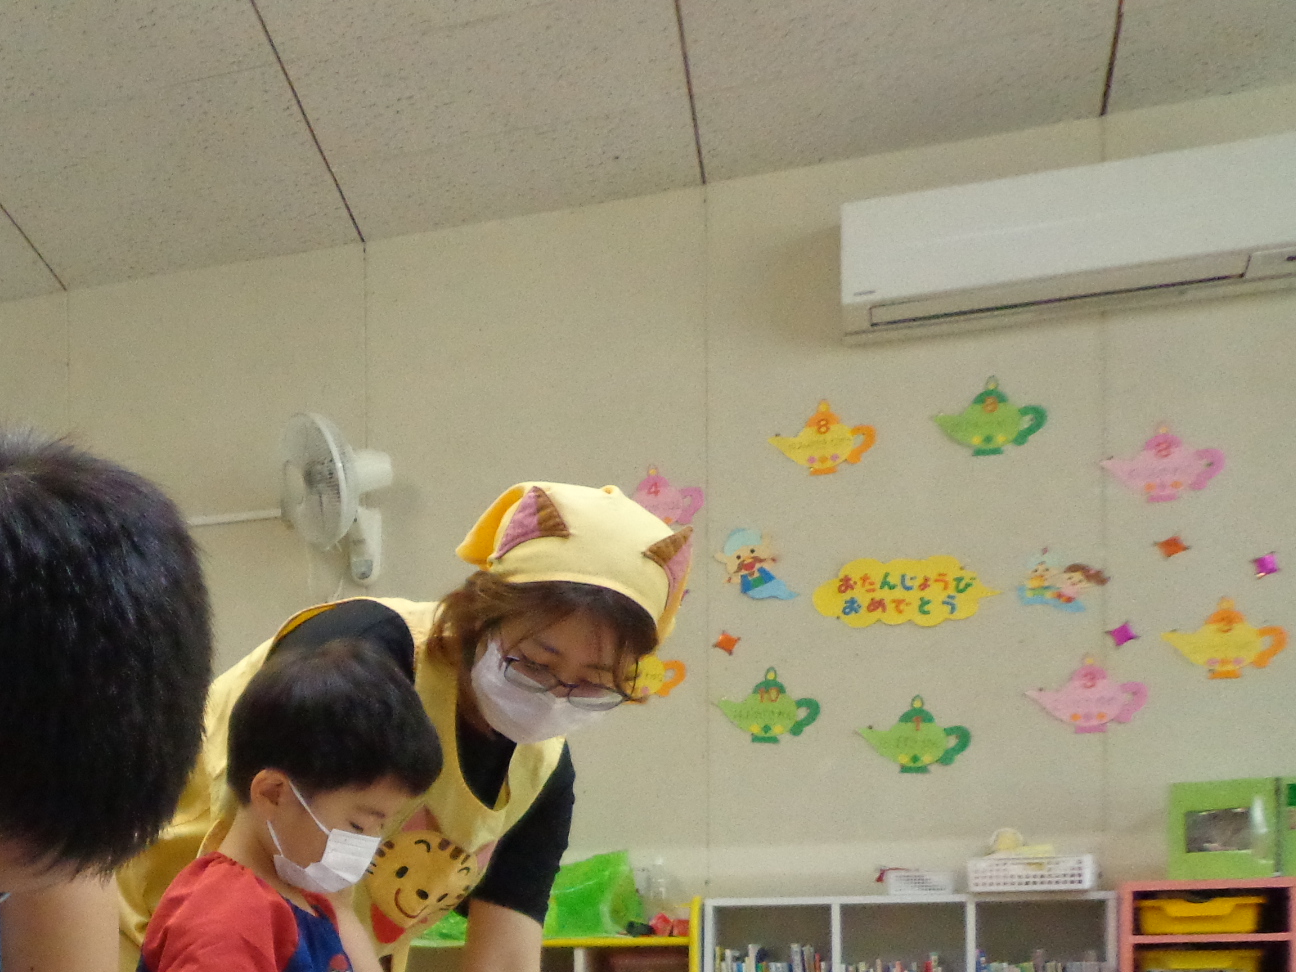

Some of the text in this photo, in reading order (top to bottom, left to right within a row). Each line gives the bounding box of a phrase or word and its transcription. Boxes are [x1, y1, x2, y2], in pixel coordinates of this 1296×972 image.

[816, 418, 830, 434] 8
[647, 482, 661, 496] 4
[838, 572, 976, 593] おたんじょうび
[842, 594, 956, 615] おめでとう
